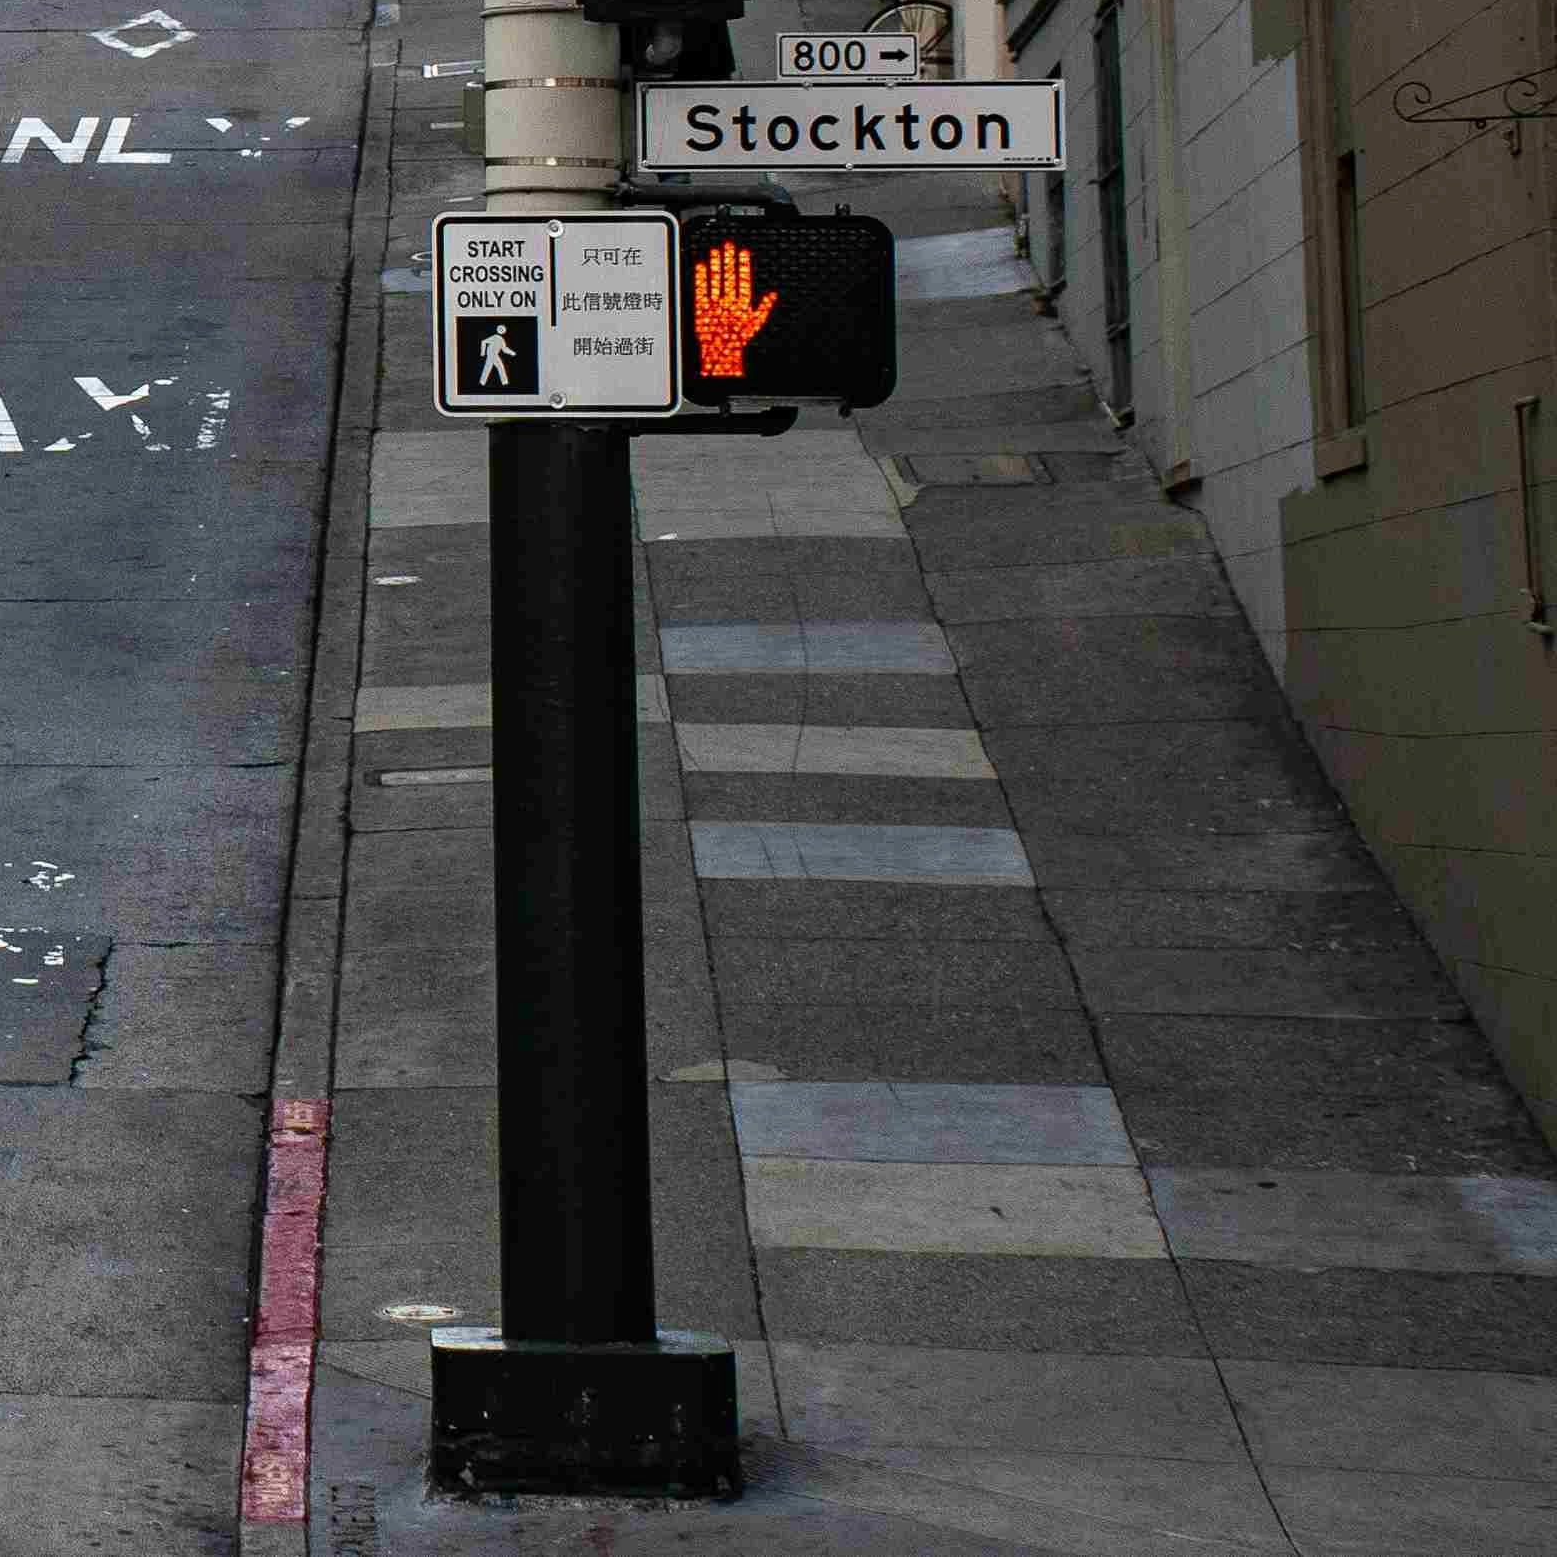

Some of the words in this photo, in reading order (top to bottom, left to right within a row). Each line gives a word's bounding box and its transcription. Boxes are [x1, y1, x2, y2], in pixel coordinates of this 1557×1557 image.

[794, 40, 866, 71] 800
[686, 103, 1012, 152] Stockton
[467, 240, 526, 258] START
[581, 247, 643, 266] 只可在
[449, 265, 545, 283] CROSSING
[457, 291, 506, 308] ONLY
[510, 291, 536, 308] ON
[561, 292, 663, 311] 此信號燈時
[573, 337, 655, 356] 開始過街
